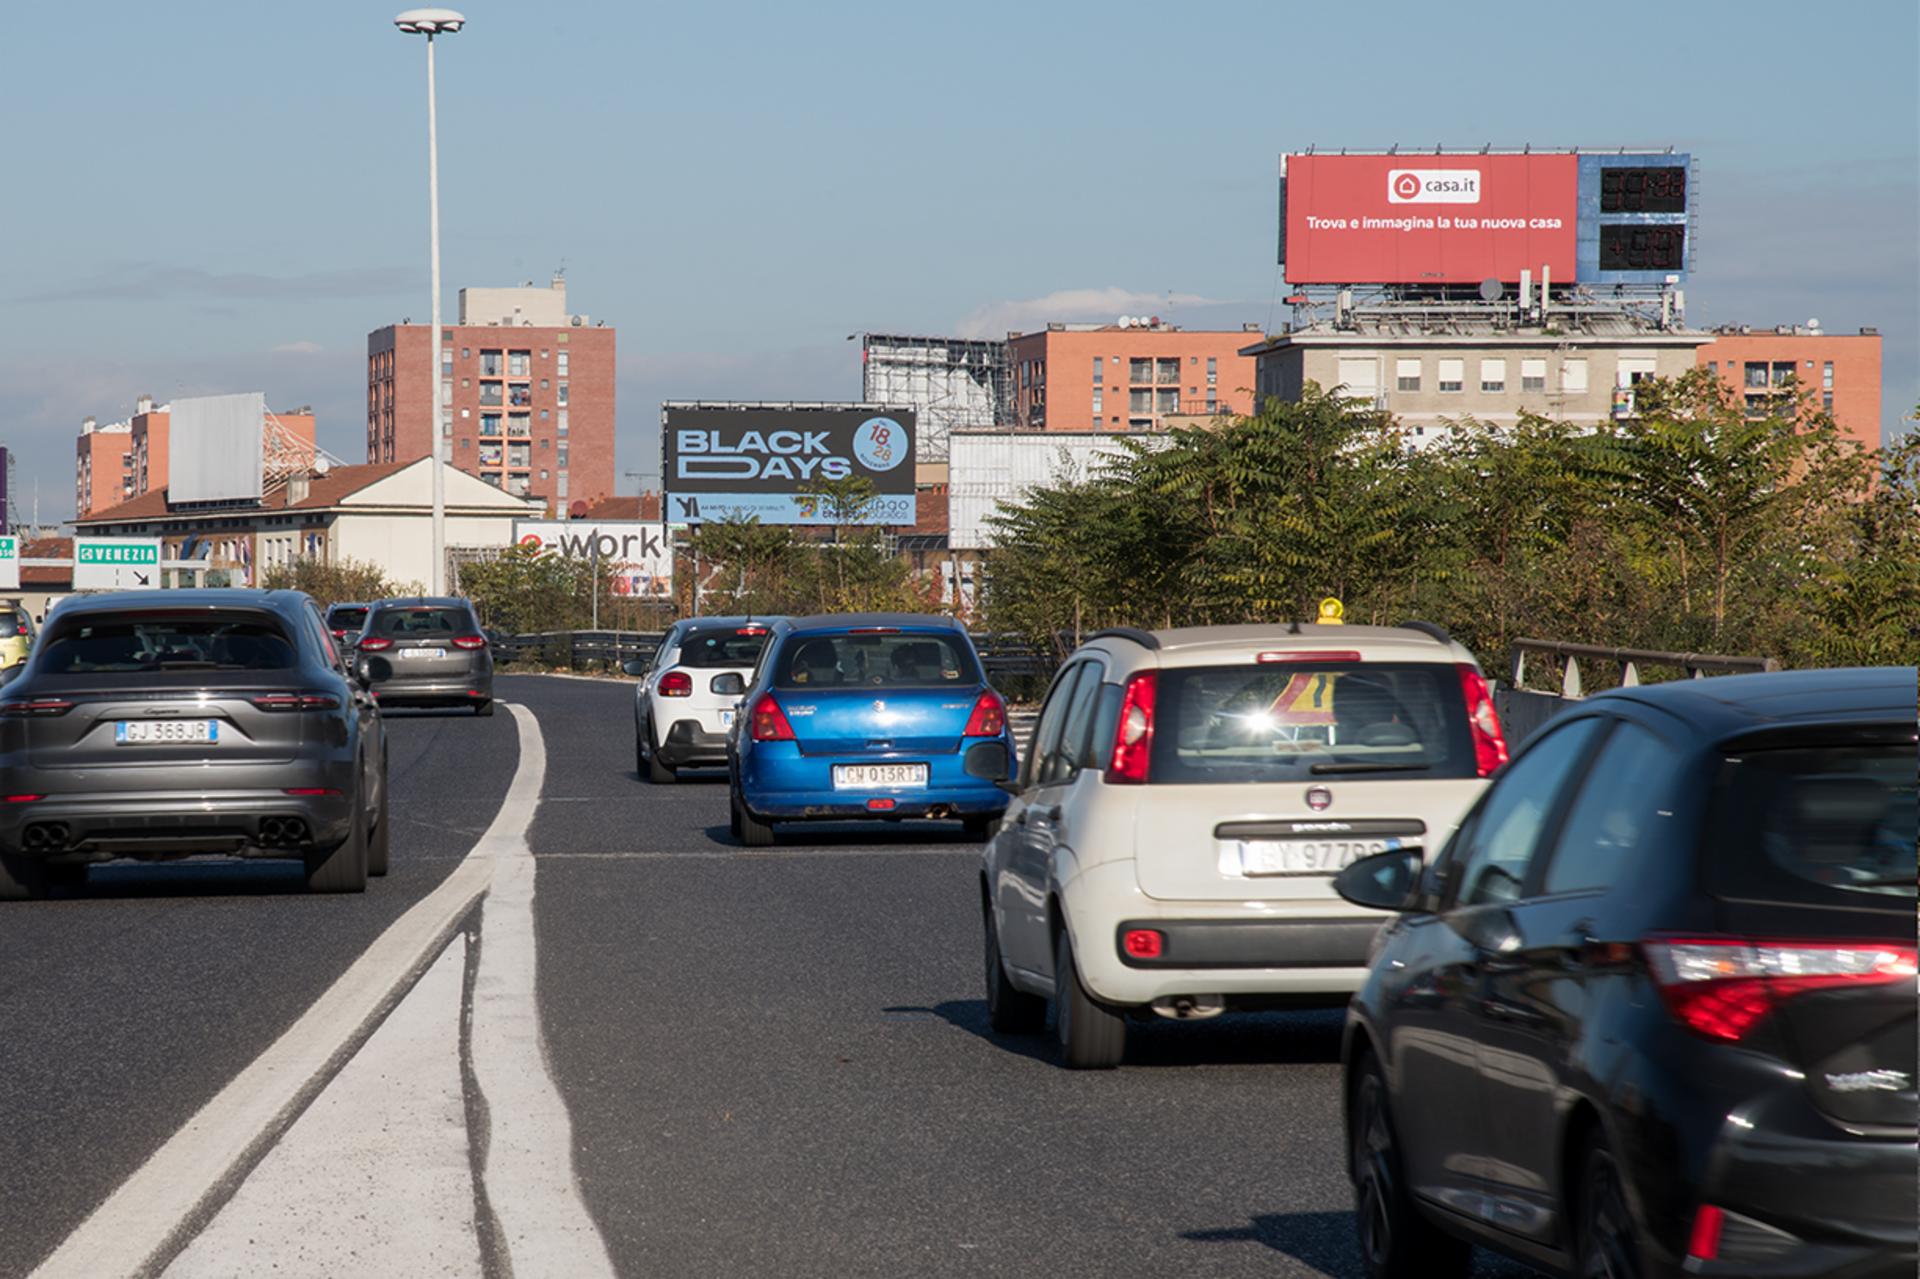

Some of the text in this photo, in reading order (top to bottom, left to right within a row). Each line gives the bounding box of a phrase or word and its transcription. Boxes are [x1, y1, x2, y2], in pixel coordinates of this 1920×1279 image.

[1425, 178, 1475, 192] casa.it
[1307, 216, 1562, 231] Trova e immagina la tua nuova casa
[677, 430, 831, 454] BLACK
[870, 424, 890, 445] 18
[872, 446, 892, 461] 28
[677, 456, 852, 480] DAYS
[95, 548, 155, 561] VENEZIA
[869, 766, 913, 782] 013RT
